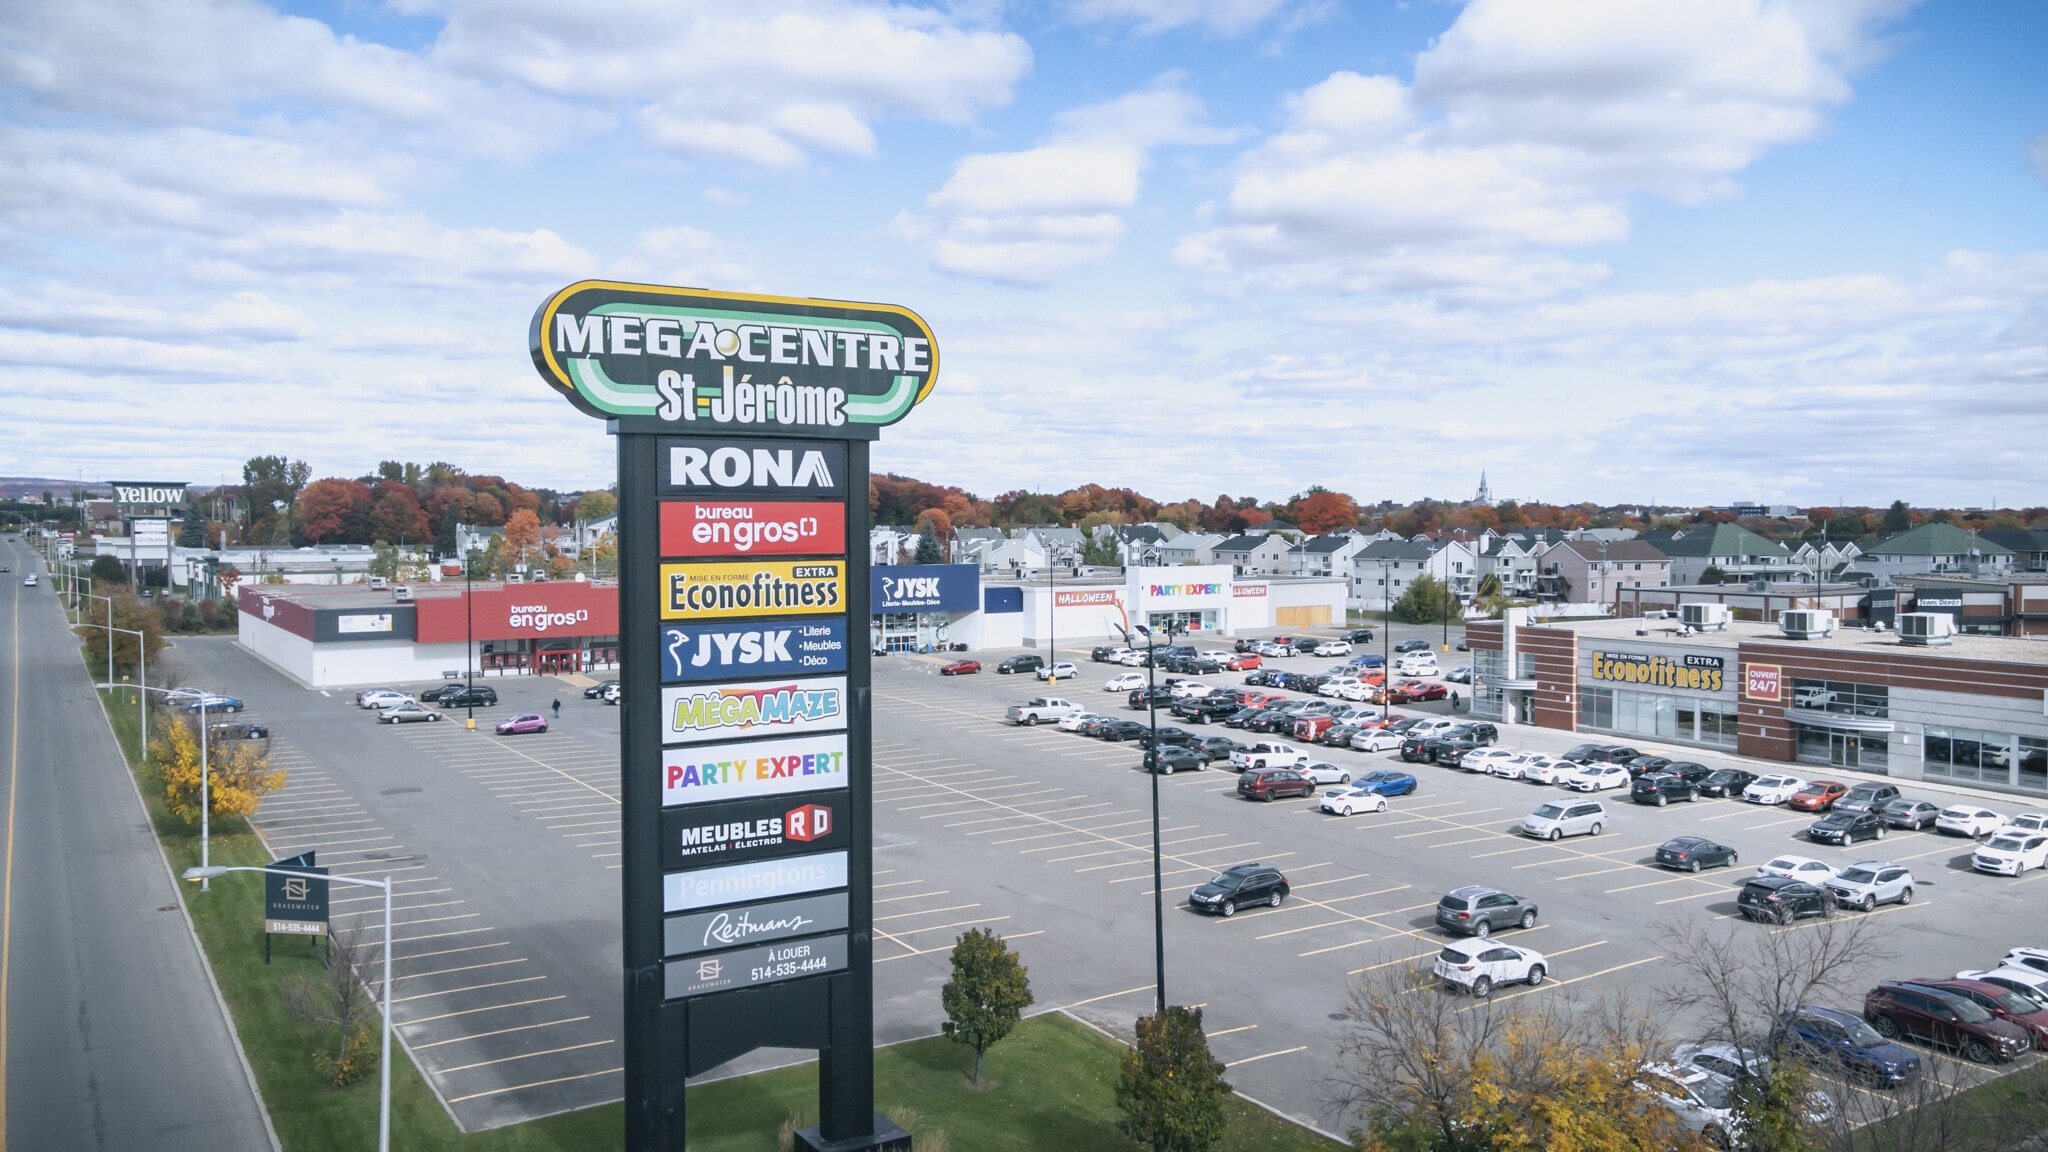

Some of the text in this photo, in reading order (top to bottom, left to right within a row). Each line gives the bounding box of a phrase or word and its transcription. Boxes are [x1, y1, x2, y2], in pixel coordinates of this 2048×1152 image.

[737, 326, 929, 372] CENTRE
[658, 365, 846, 427] St-Jérôme
[670, 447, 834, 488] RONA
[115, 486, 184, 503] Yellow
[695, 505, 753, 520] bureau
[692, 520, 798, 551] en gros
[796, 567, 834, 577] EXTRA
[893, 577, 940, 599] JYSK
[1150, 583, 1222, 596] PARTY EXPERT
[1233, 586, 1265, 596] LLOWEEN
[1058, 593, 1113, 605] HALLOWEEN
[511, 605, 547, 613] bureau
[534, 612, 576, 631] gros
[803, 626, 831, 636] Literie
[691, 630, 793, 667] JYSK
[803, 640, 842, 651] Meubles
[803, 656, 828, 666] Déco
[1686, 656, 1720, 667] EXTRA
[1750, 670, 1777, 680] OUVERT
[1749, 679, 1777, 693] 24/7
[667, 751, 843, 789] PARTY EXPERT
[682, 818, 782, 846] MEUBLES
[682, 836, 783, 856] MATELAS ÉLECTROS
[680, 862, 827, 898] Penningtons
[273, 922, 320, 933] 514-535-4444
[703, 911, 813, 946] Reitmans
[768, 945, 810, 963] À LOUER
[751, 956, 827, 981] 514-535-4444
[688, 979, 731, 991] BRASSWATER
